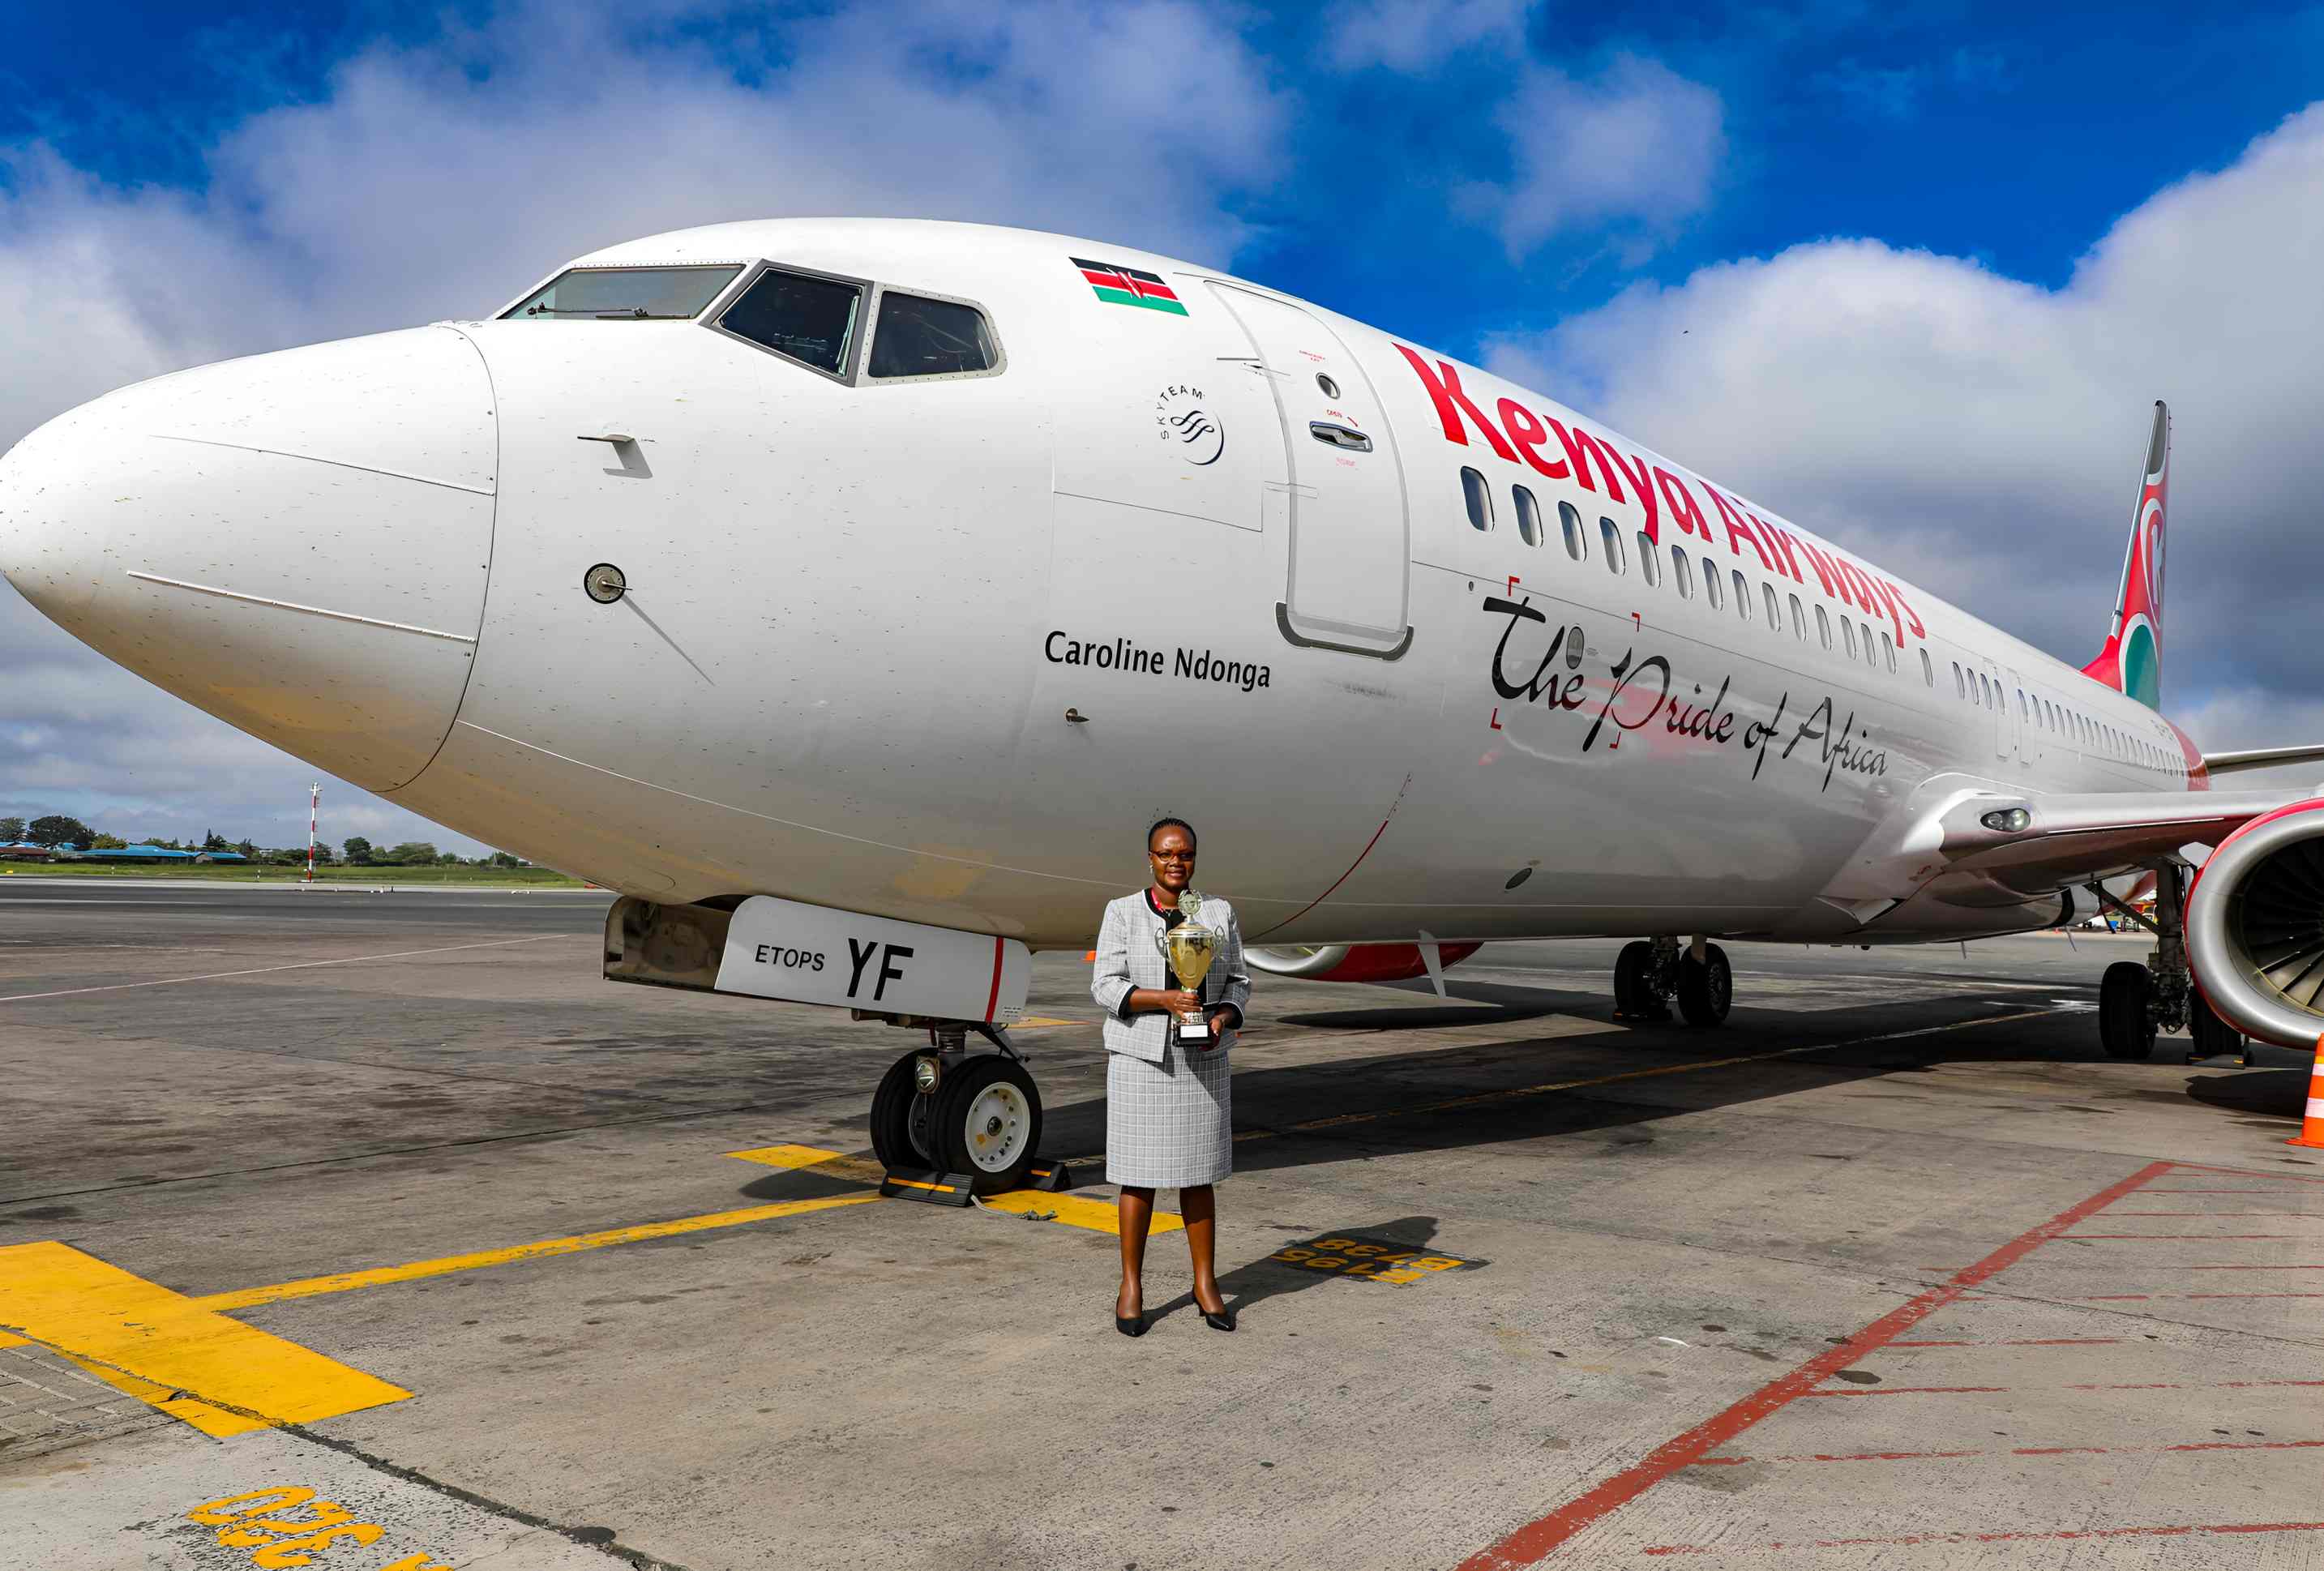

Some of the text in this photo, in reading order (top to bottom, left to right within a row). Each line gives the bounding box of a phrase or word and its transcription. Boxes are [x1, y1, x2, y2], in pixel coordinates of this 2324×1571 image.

[1156, 385, 1202, 440] SKYTEAM
[1391, 341, 1926, 649] Kenya Airways
[1045, 630, 1271, 693] Caroline Ndonga
[1483, 596, 1889, 793] The Pride of Africa
[755, 938, 914, 1001] ETOPS YF
